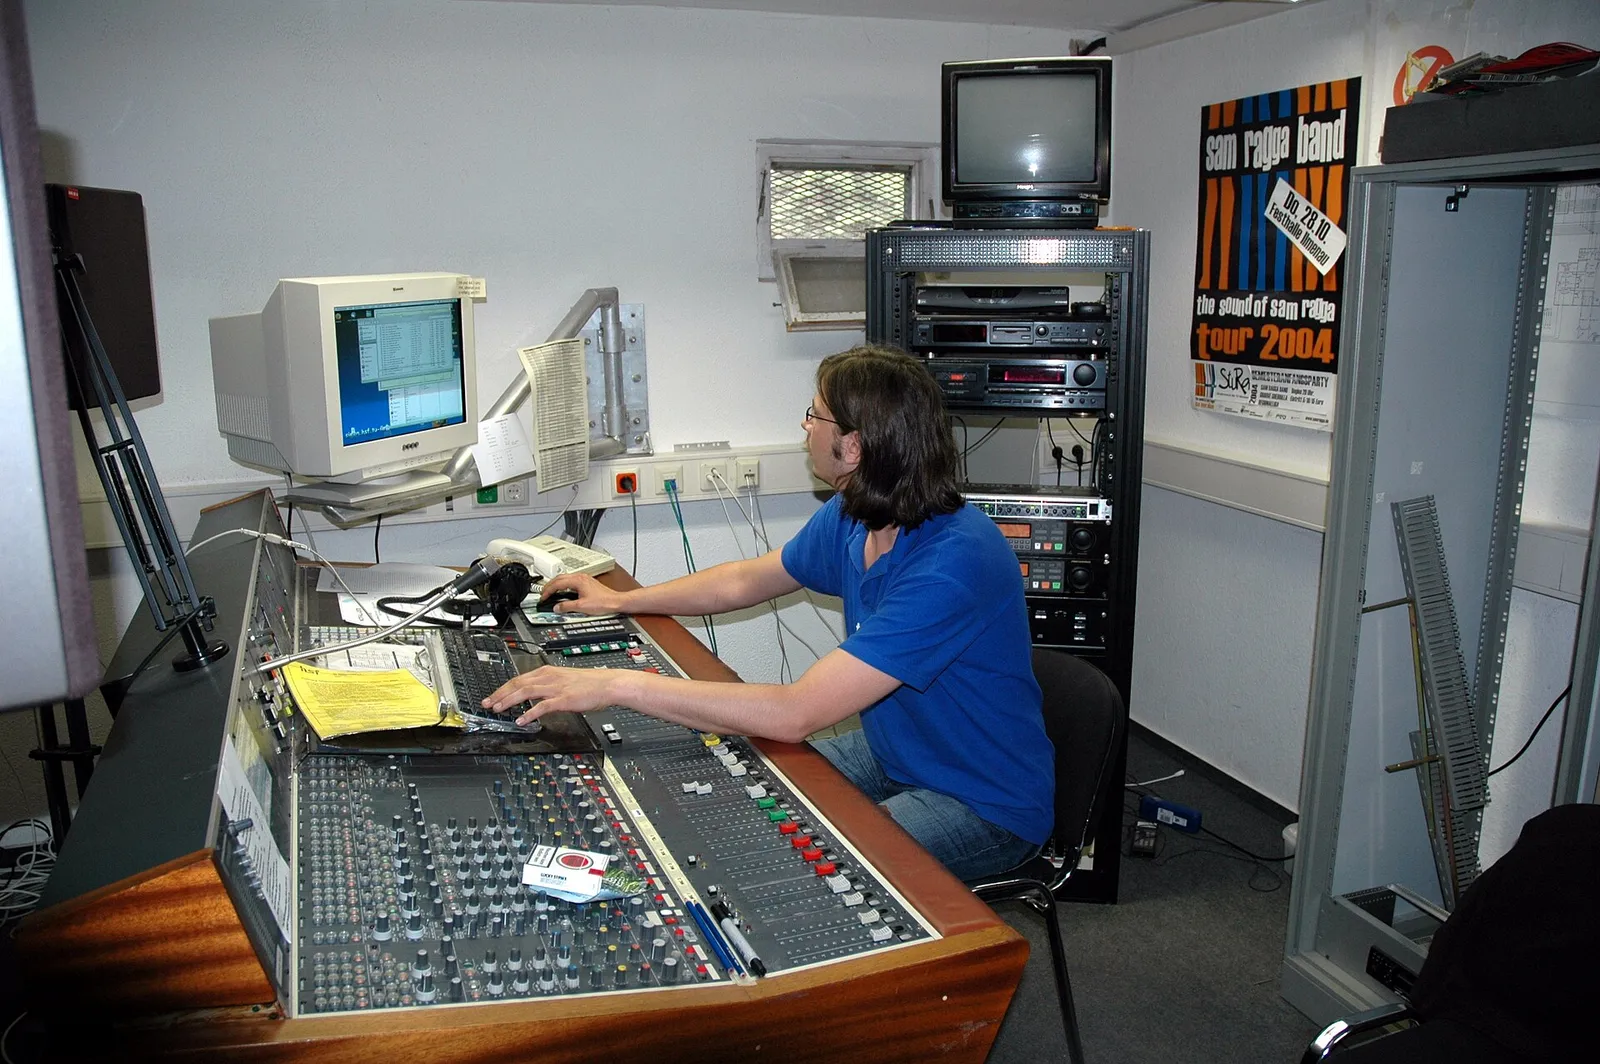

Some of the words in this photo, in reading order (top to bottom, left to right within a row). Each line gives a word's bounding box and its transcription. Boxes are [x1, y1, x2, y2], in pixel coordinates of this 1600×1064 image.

[1206, 133, 1237, 171] sam
[1244, 125, 1290, 172] ragga
[1296, 109, 1347, 164] band
[1269, 202, 1303, 240] Festhalle
[1300, 232, 1330, 266] Ilmenau
[1300, 205, 1331, 244] 28.10.
[1196, 294, 1215, 316] the
[1219, 293, 1253, 317] sound
[1253, 295, 1269, 318] of
[1270, 299, 1298, 320] sam
[1301, 298, 1336, 323] ragga
[1196, 322, 1254, 360] tour
[1259, 324, 1335, 364] 2004
[1249, 384, 1258, 404] 2004
